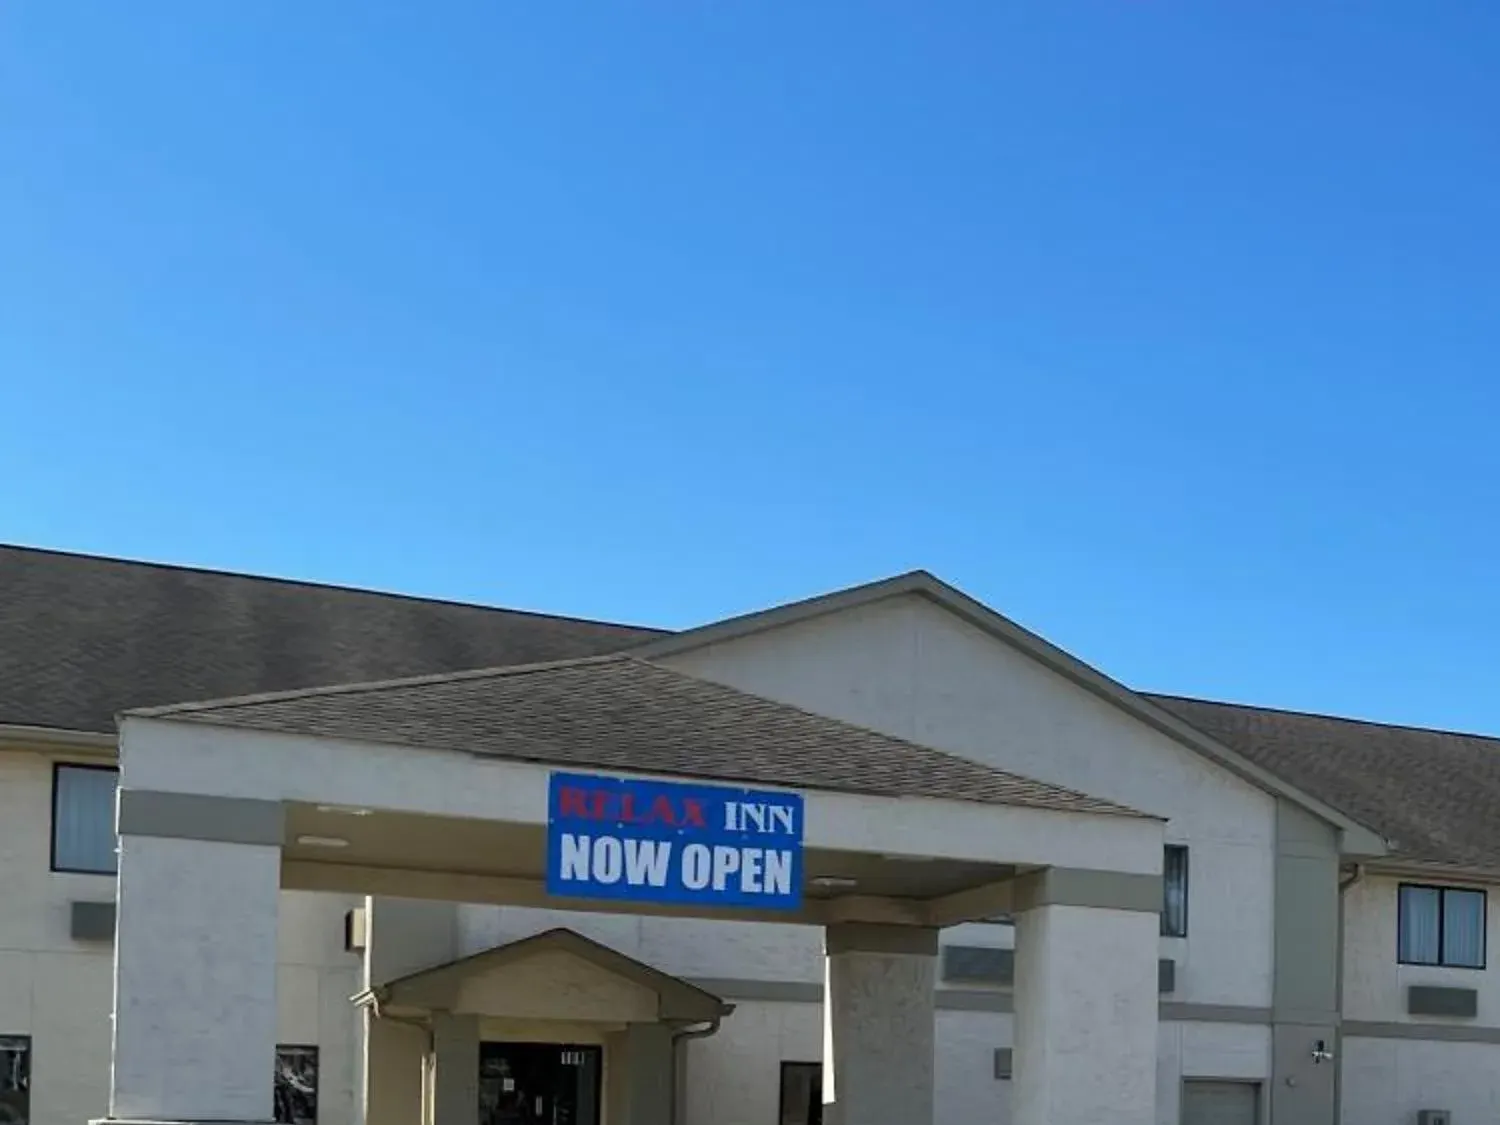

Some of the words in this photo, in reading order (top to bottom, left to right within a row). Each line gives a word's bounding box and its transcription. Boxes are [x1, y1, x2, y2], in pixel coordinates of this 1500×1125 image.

[559, 785, 708, 829] RELAX
[724, 801, 795, 835] INN
[560, 833, 672, 887] NOW
[681, 843, 792, 895] OPEN
